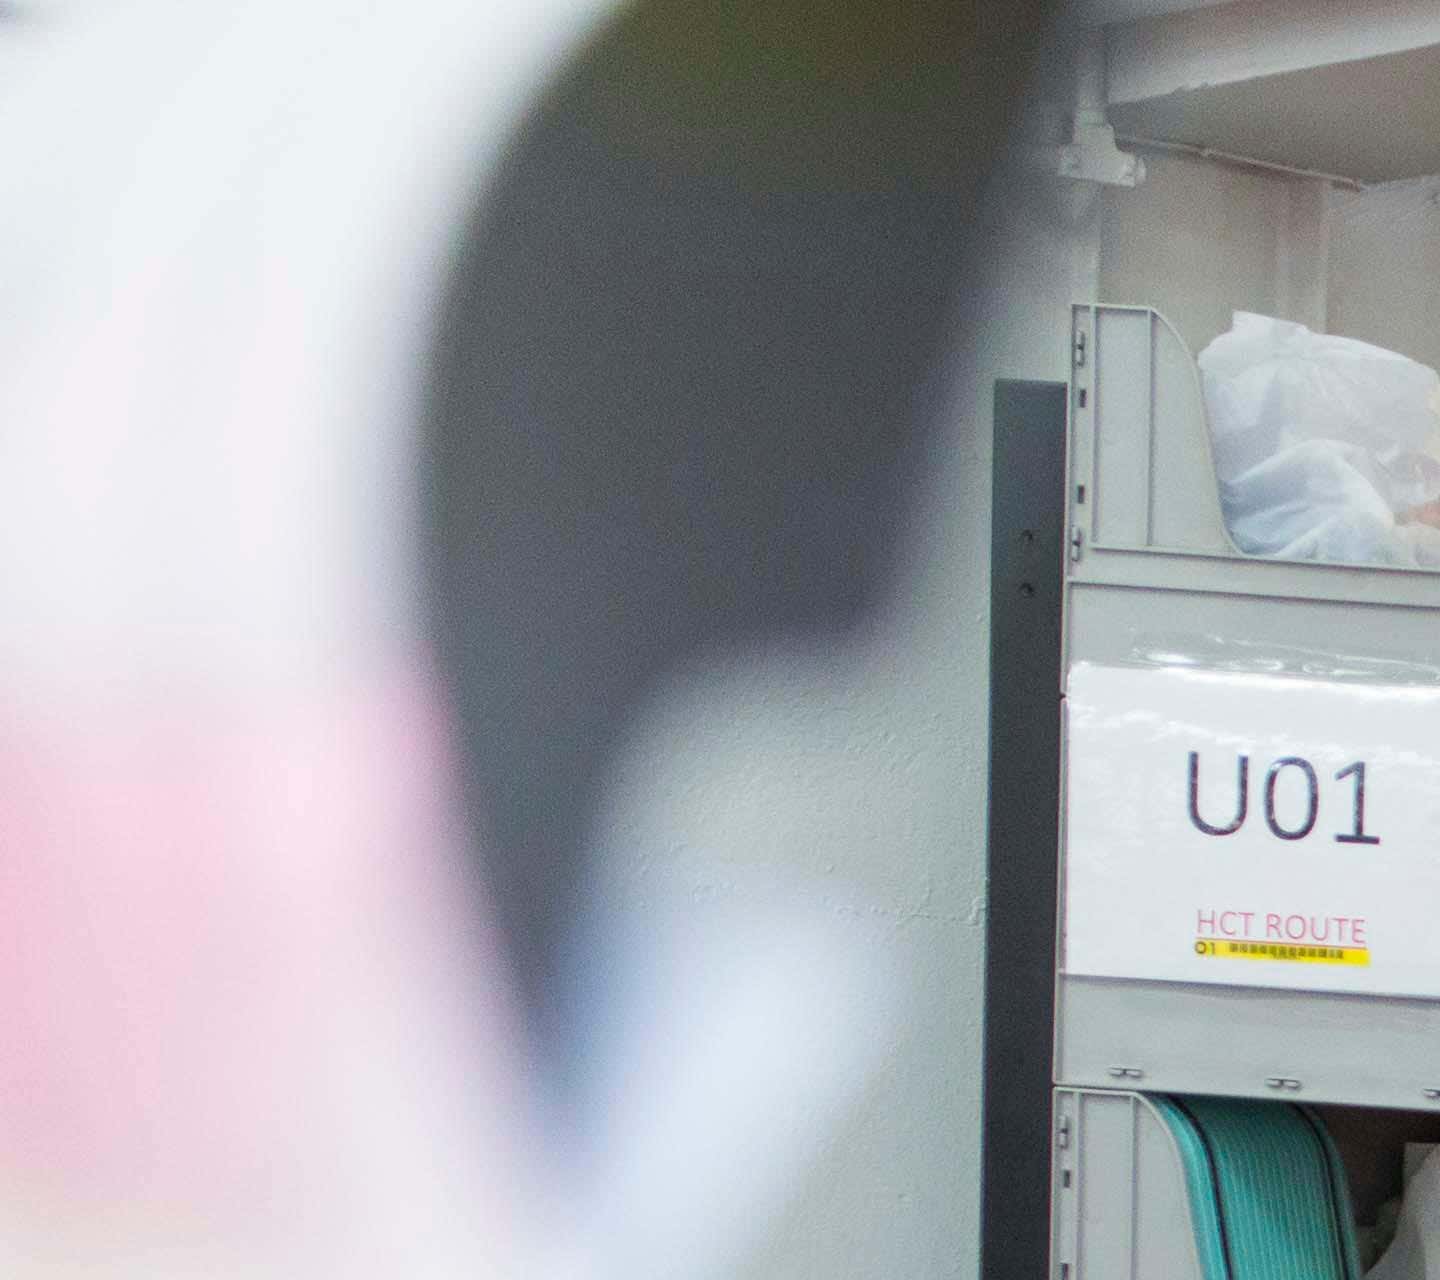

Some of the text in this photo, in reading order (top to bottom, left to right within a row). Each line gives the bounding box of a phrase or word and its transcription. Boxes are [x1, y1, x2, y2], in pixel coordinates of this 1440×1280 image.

[1186, 750, 1381, 846] U01
[1196, 909, 1366, 944] HCT ROUTE
